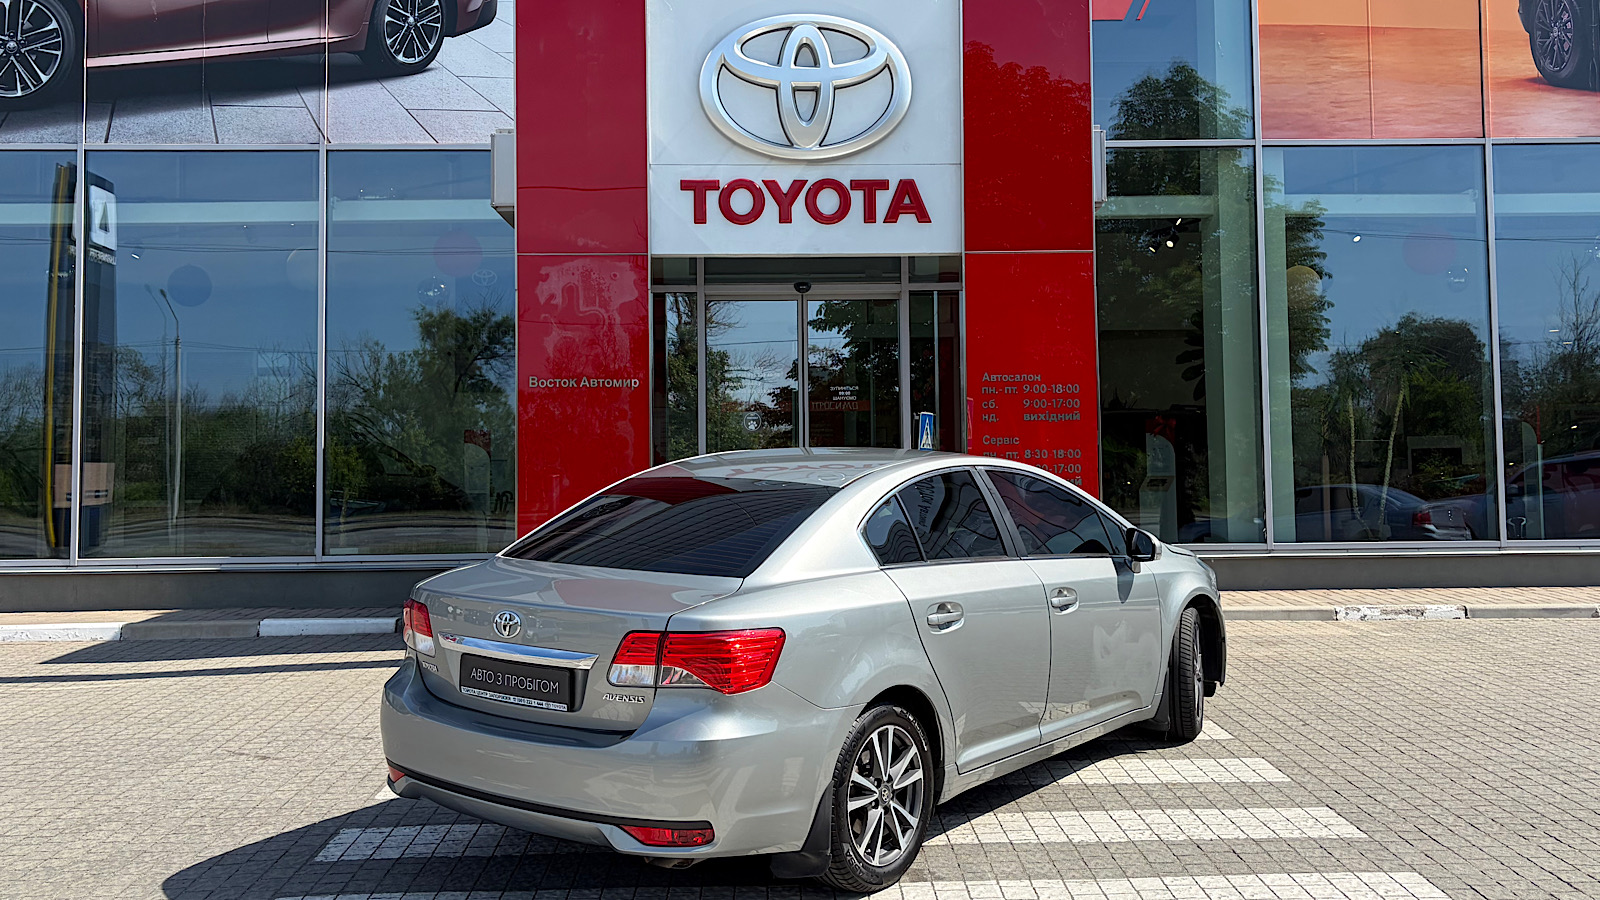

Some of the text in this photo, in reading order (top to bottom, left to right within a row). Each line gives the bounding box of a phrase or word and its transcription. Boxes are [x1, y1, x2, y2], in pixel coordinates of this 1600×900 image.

[680, 178, 932, 225] TOYOTA
[982, 372, 1041, 382] Автосалон
[529, 376, 640, 390] Восток Автомир
[982, 399, 1080, 409] сб. 9:00-17:00
[982, 411, 1081, 422] нд. вихідний
[982, 435, 1020, 446] Сервіс
[470, 667, 495, 684] АВТО
[504, 674, 559, 694] ПРОБІГОМ
[602, 693, 646, 704] AVENSIS
